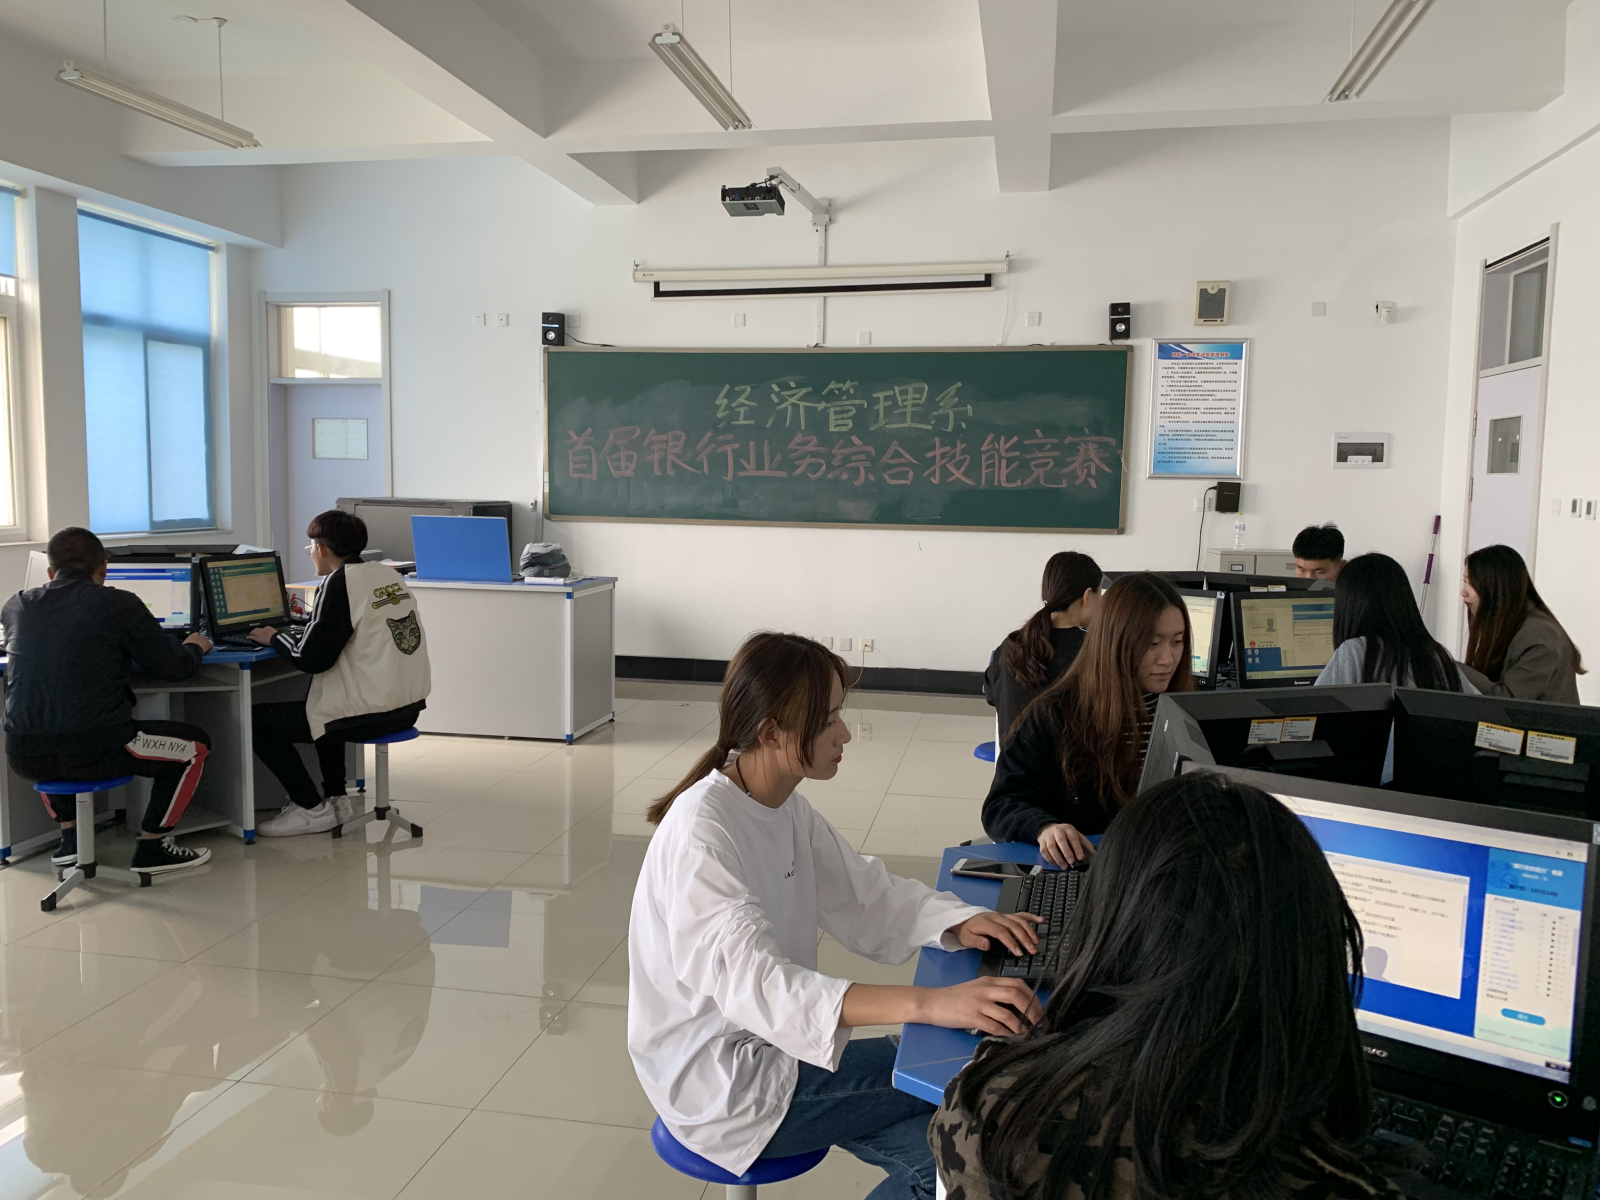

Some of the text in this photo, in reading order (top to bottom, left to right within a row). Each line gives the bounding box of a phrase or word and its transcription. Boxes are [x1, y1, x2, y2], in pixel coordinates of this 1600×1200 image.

[714, 379, 973, 433] 经济管理系
[562, 427, 1117, 489] 首届银行业务综合技能竞赛
[373, 583, 403, 598] GUCCI
[142, 737, 167, 750] WXH
[168, 741, 187, 753] NYA
